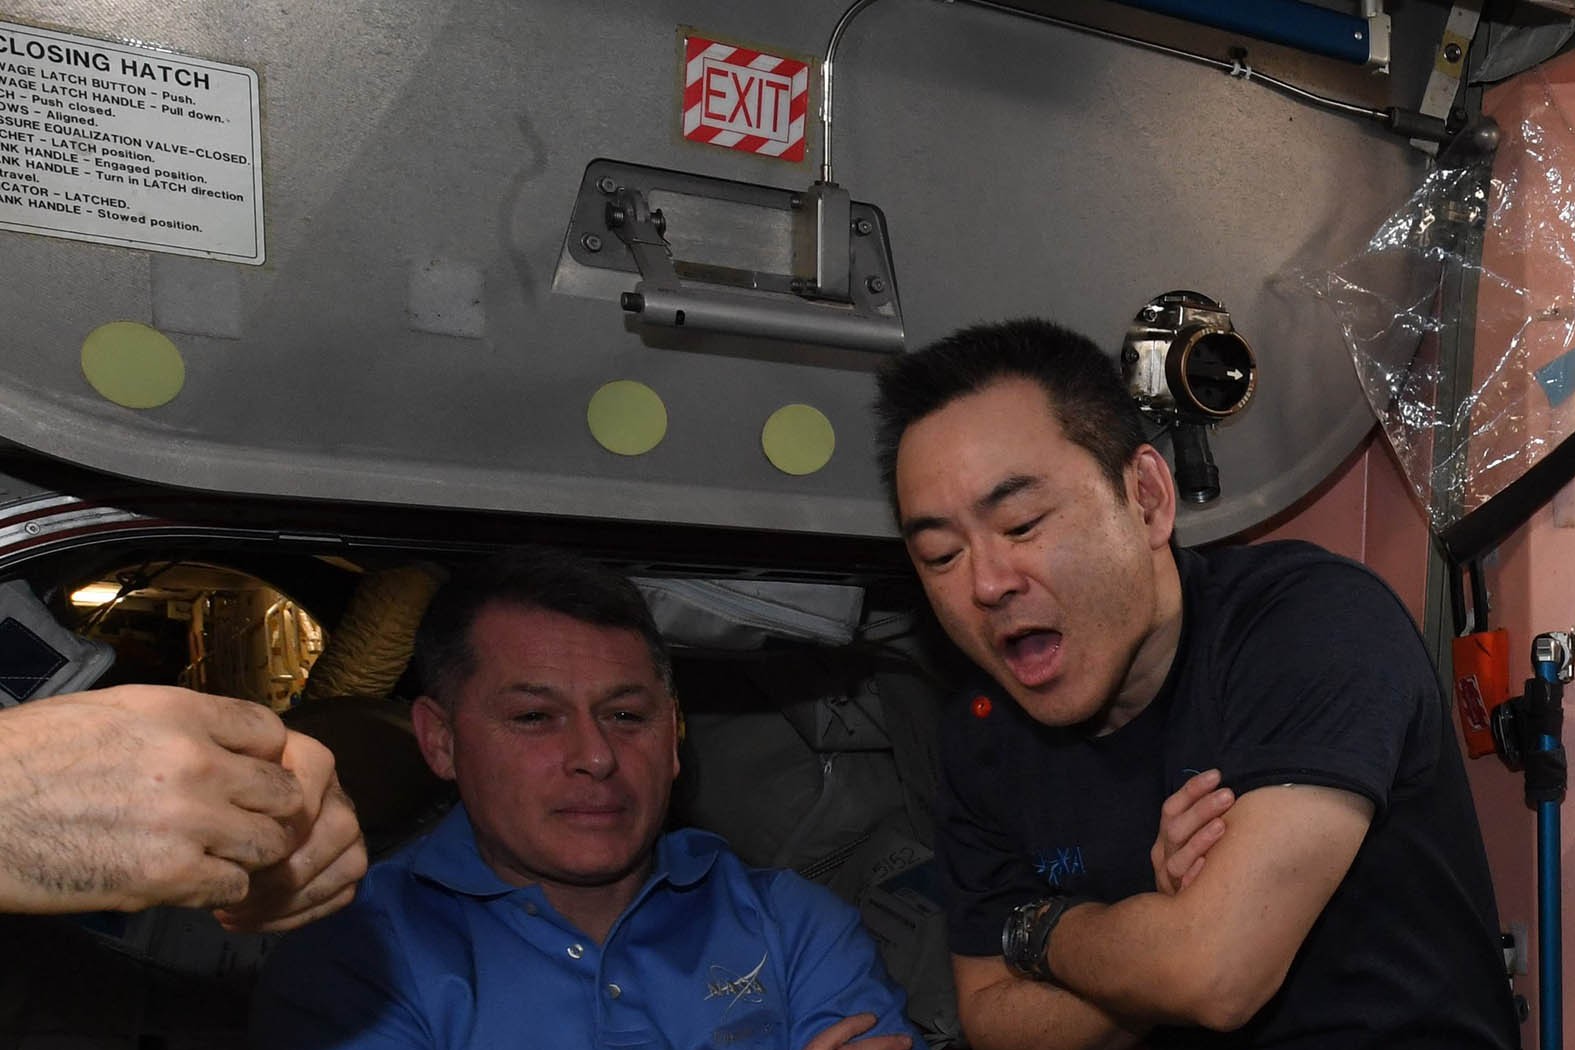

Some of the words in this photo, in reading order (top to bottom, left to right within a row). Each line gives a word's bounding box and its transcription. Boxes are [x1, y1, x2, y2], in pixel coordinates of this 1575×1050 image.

[41, 69, 87, 86] LATCH
[92, 79, 147, 96] BUTTON
[162, 91, 196, 105] Push.
[121, 59, 210, 90] HATCH
[32, 95, 63, 108] Push
[68, 102, 116, 117] closed.
[42, 83, 88, 99] LATCH
[92, 92, 146, 110] HANDLE
[161, 104, 183, 117] Pull
[188, 109, 225, 124] down.
[704, 67, 789, 132] EXIT
[47, 110, 98, 127] Aligned.
[0, 129, 34, 143] CHET
[52, 138, 97, 153] LATCH
[101, 148, 155, 162] position.
[44, 123, 142, 147] EQUALIZATION
[146, 139, 250, 165] VALVE-CLOSED.
[0, 155, 20, 167] NK
[26, 159, 80, 176] HANDLE
[96, 170, 124, 184] Turn
[128, 176, 139, 186] in
[143, 178, 187, 193] LATCH
[191, 186, 244, 202] direction
[25, 146, 79, 163] HANDLE
[95, 158, 150, 175] Engaged
[155, 169, 207, 184] position.
[28, 198, 81, 215] HANDLE
[98, 208, 146, 225] Stowed
[150, 218, 203, 233] position.
[65, 191, 130, 210] LATCHED.
